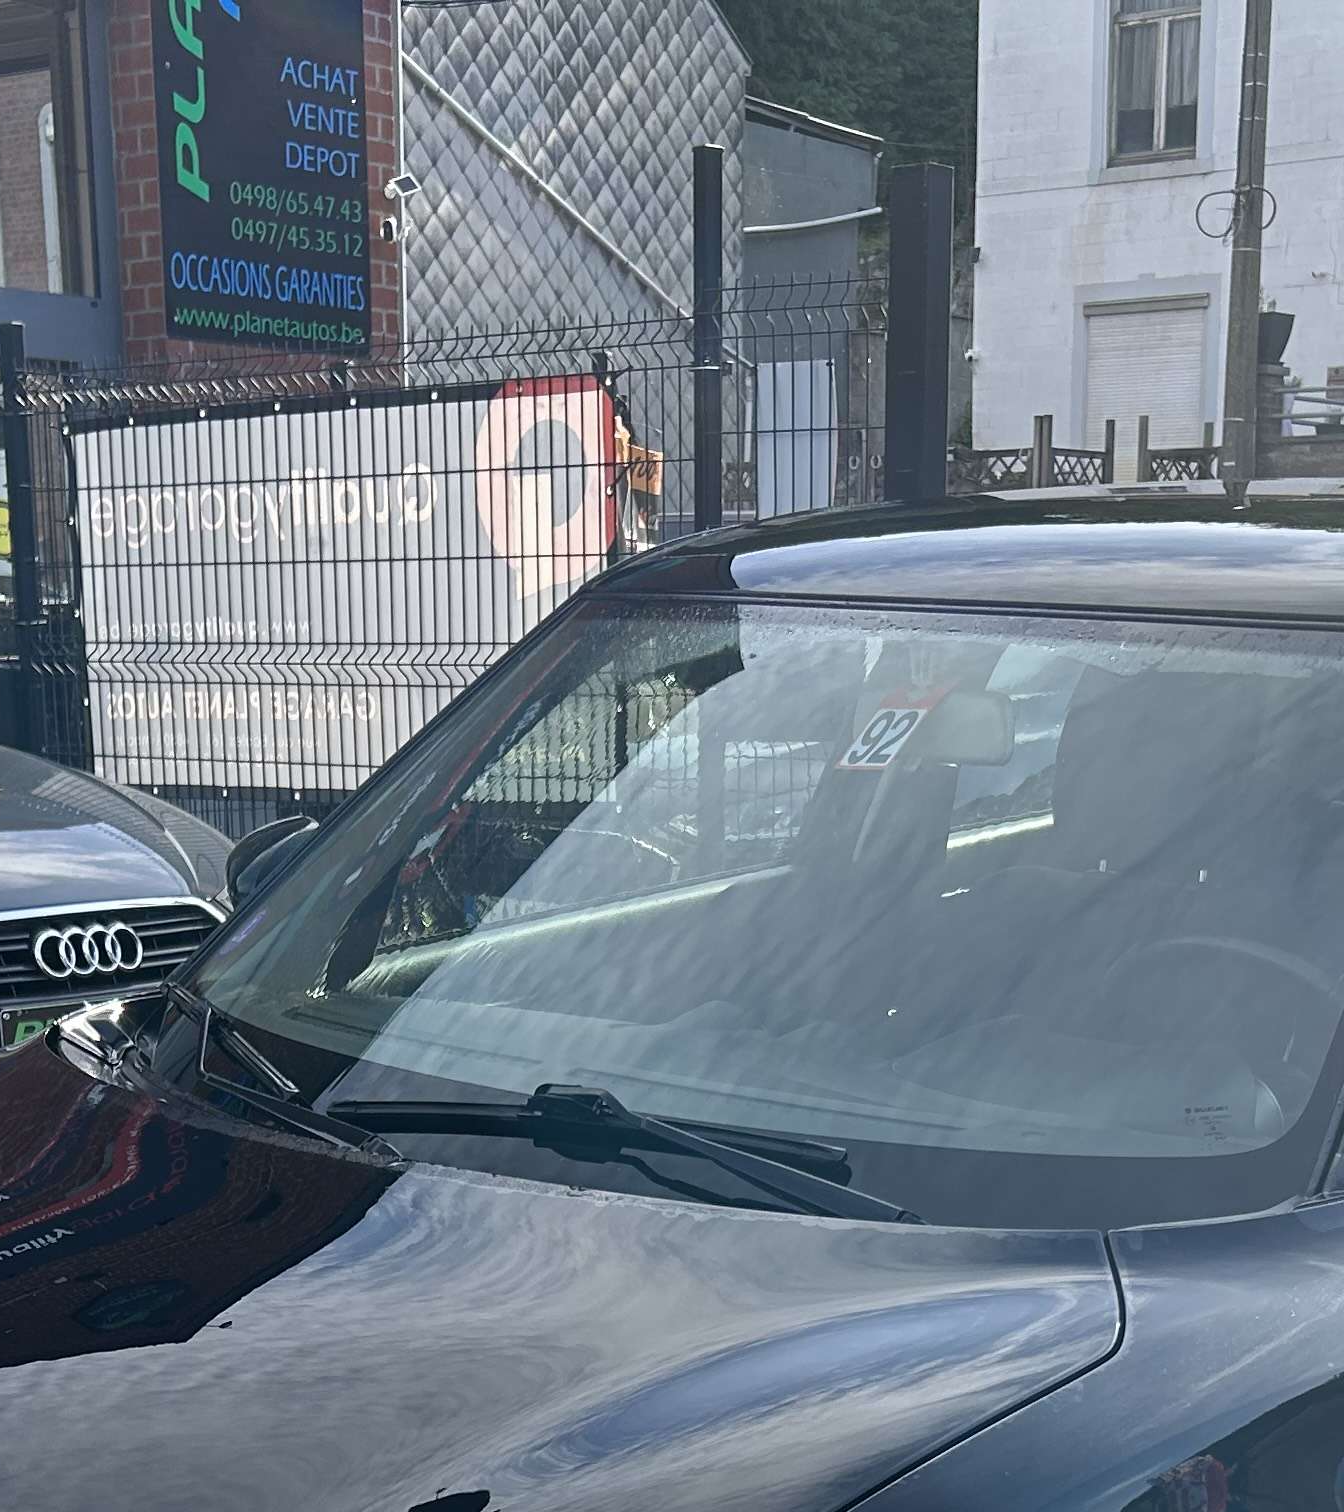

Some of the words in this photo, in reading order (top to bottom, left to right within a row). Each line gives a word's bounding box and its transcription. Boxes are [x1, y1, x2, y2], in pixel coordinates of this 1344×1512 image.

[280, 57, 359, 97] ACHAT
[287, 100, 360, 138] VENTE
[285, 142, 360, 178] DEPOT
[229, 181, 362, 223] 0498/65.47.43
[231, 217, 363, 257] 0497/45.35.12
[170, 251, 271, 300] OCCASIONS
[275, 266, 365, 311] GARANTIES
[175, 307, 363, 342] www.planetautos.be
[847, 710, 919, 765] 92
